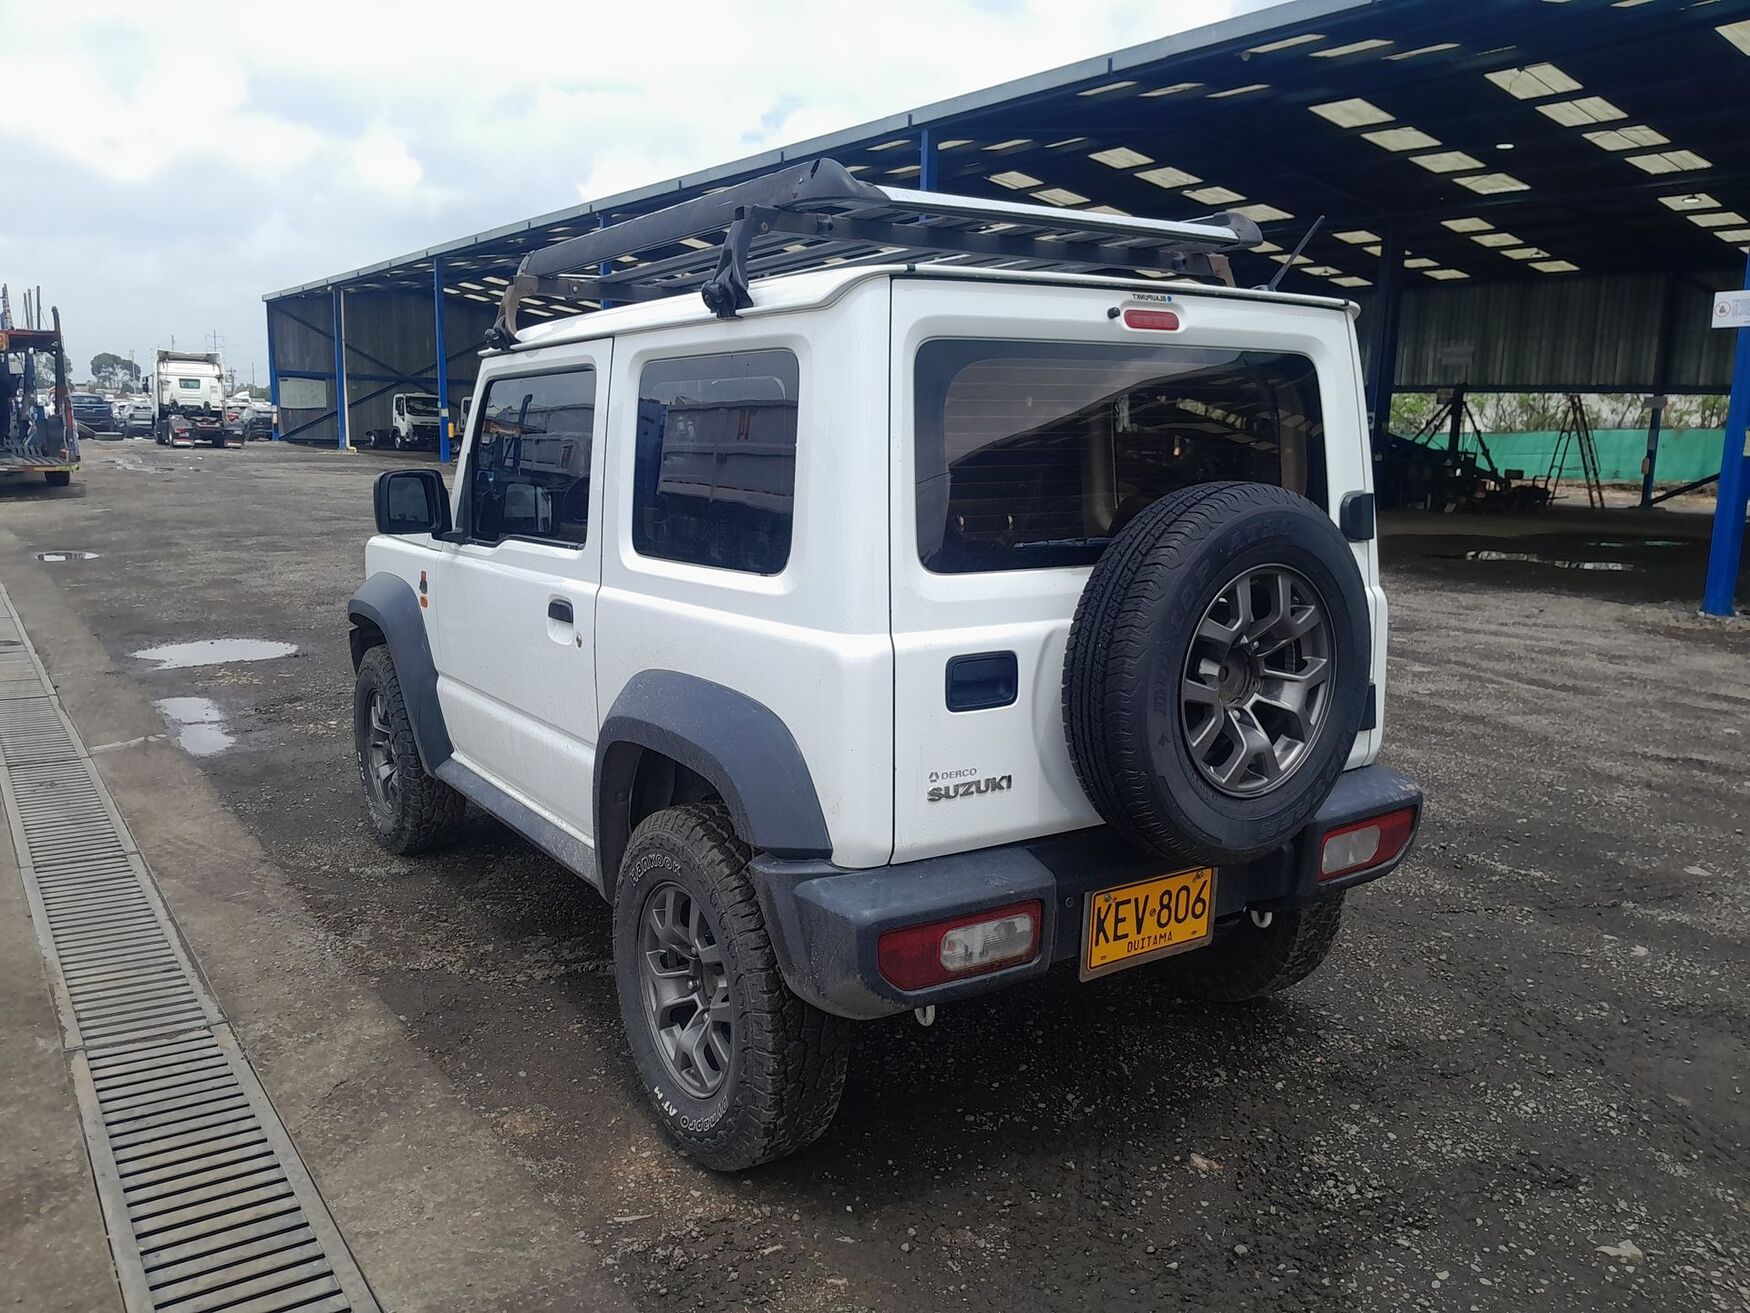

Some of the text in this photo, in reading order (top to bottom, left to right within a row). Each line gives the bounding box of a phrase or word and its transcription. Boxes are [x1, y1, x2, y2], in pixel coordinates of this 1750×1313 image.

[941, 767, 977, 780] DERCO
[927, 774, 1012, 803] SUZUKI
[1156, 879, 1208, 929] 806
[1126, 930, 1173, 953] DUITAMA
